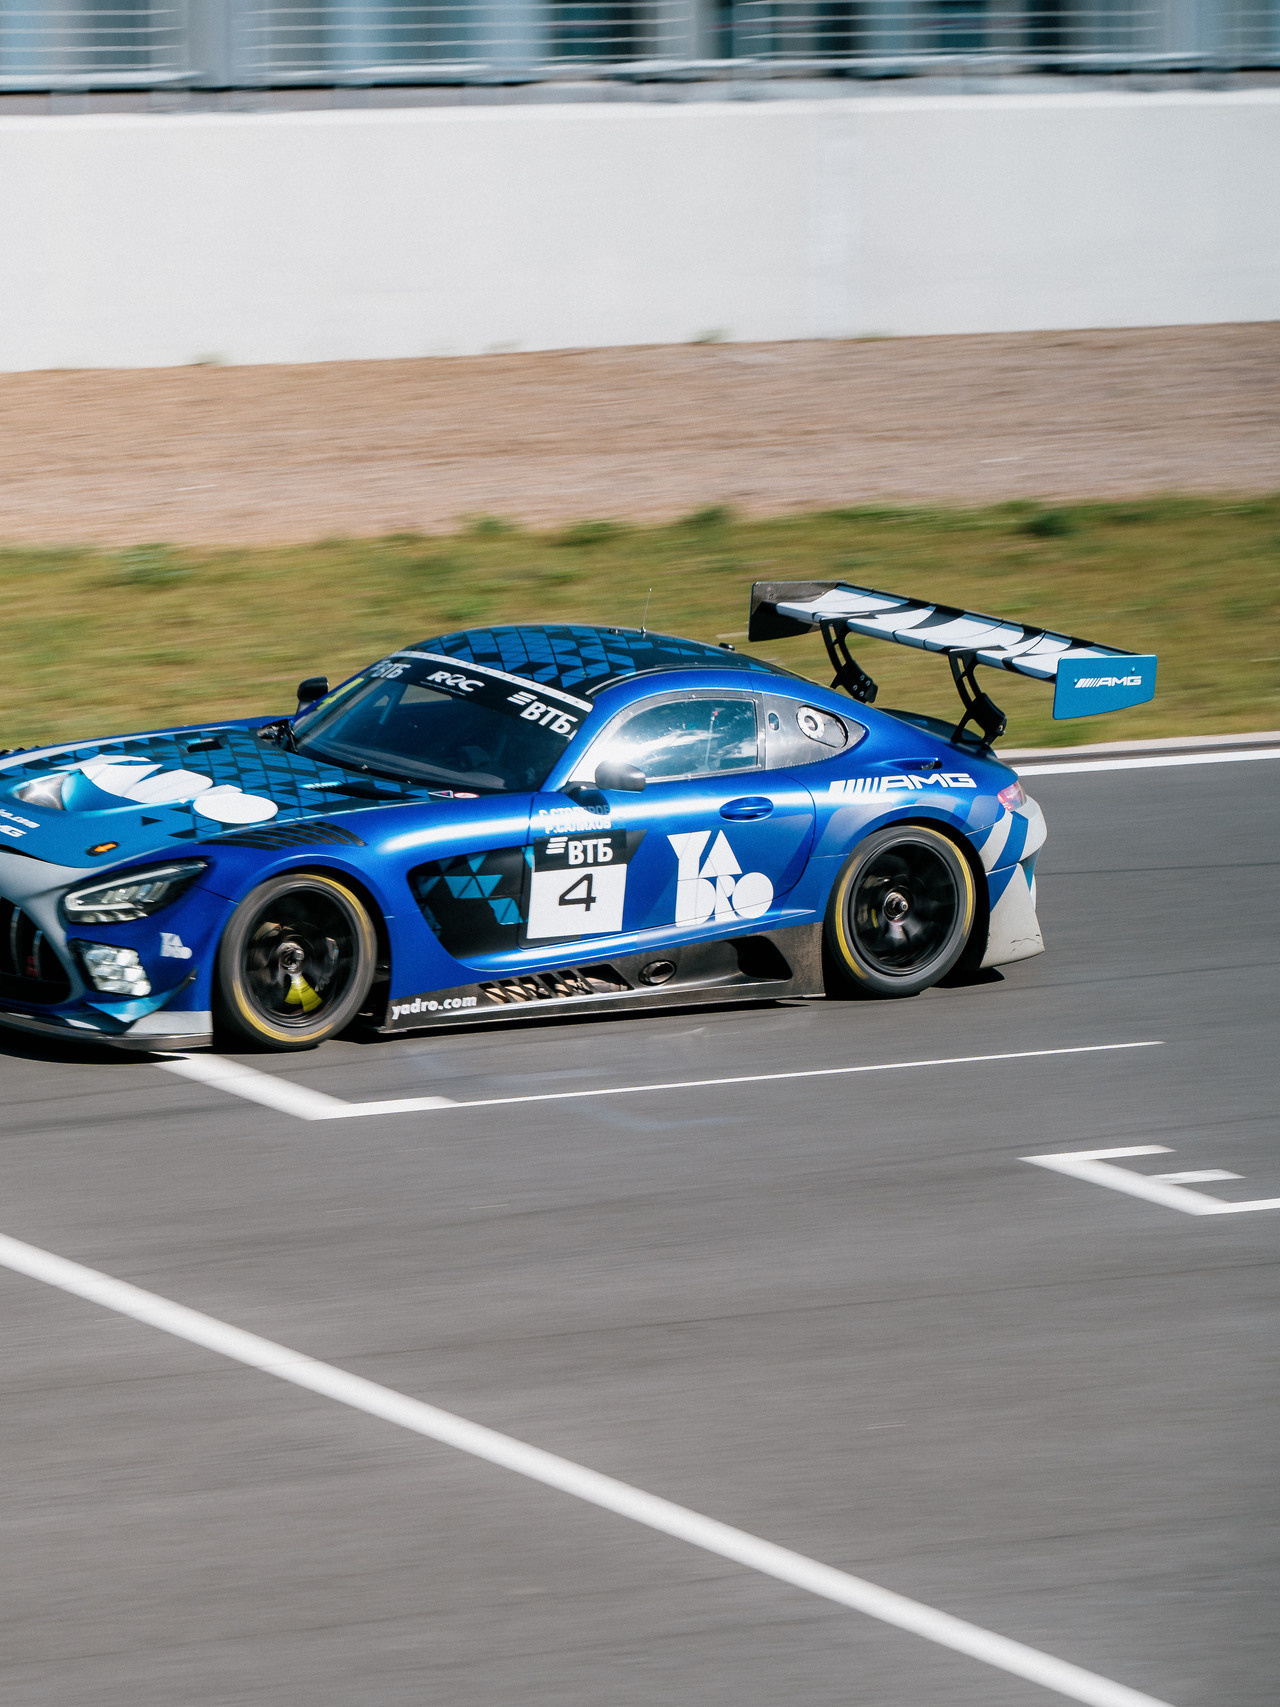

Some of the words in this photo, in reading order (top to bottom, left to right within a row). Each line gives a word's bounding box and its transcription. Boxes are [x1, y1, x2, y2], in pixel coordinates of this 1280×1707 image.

[1096, 675, 1142, 687] AMG
[520, 701, 579, 734] ВТБ
[878, 773, 978, 793] AMG
[568, 837, 614, 866] ВТБ
[558, 873, 597, 912] 4
[392, 997, 478, 1020] yadro.com
